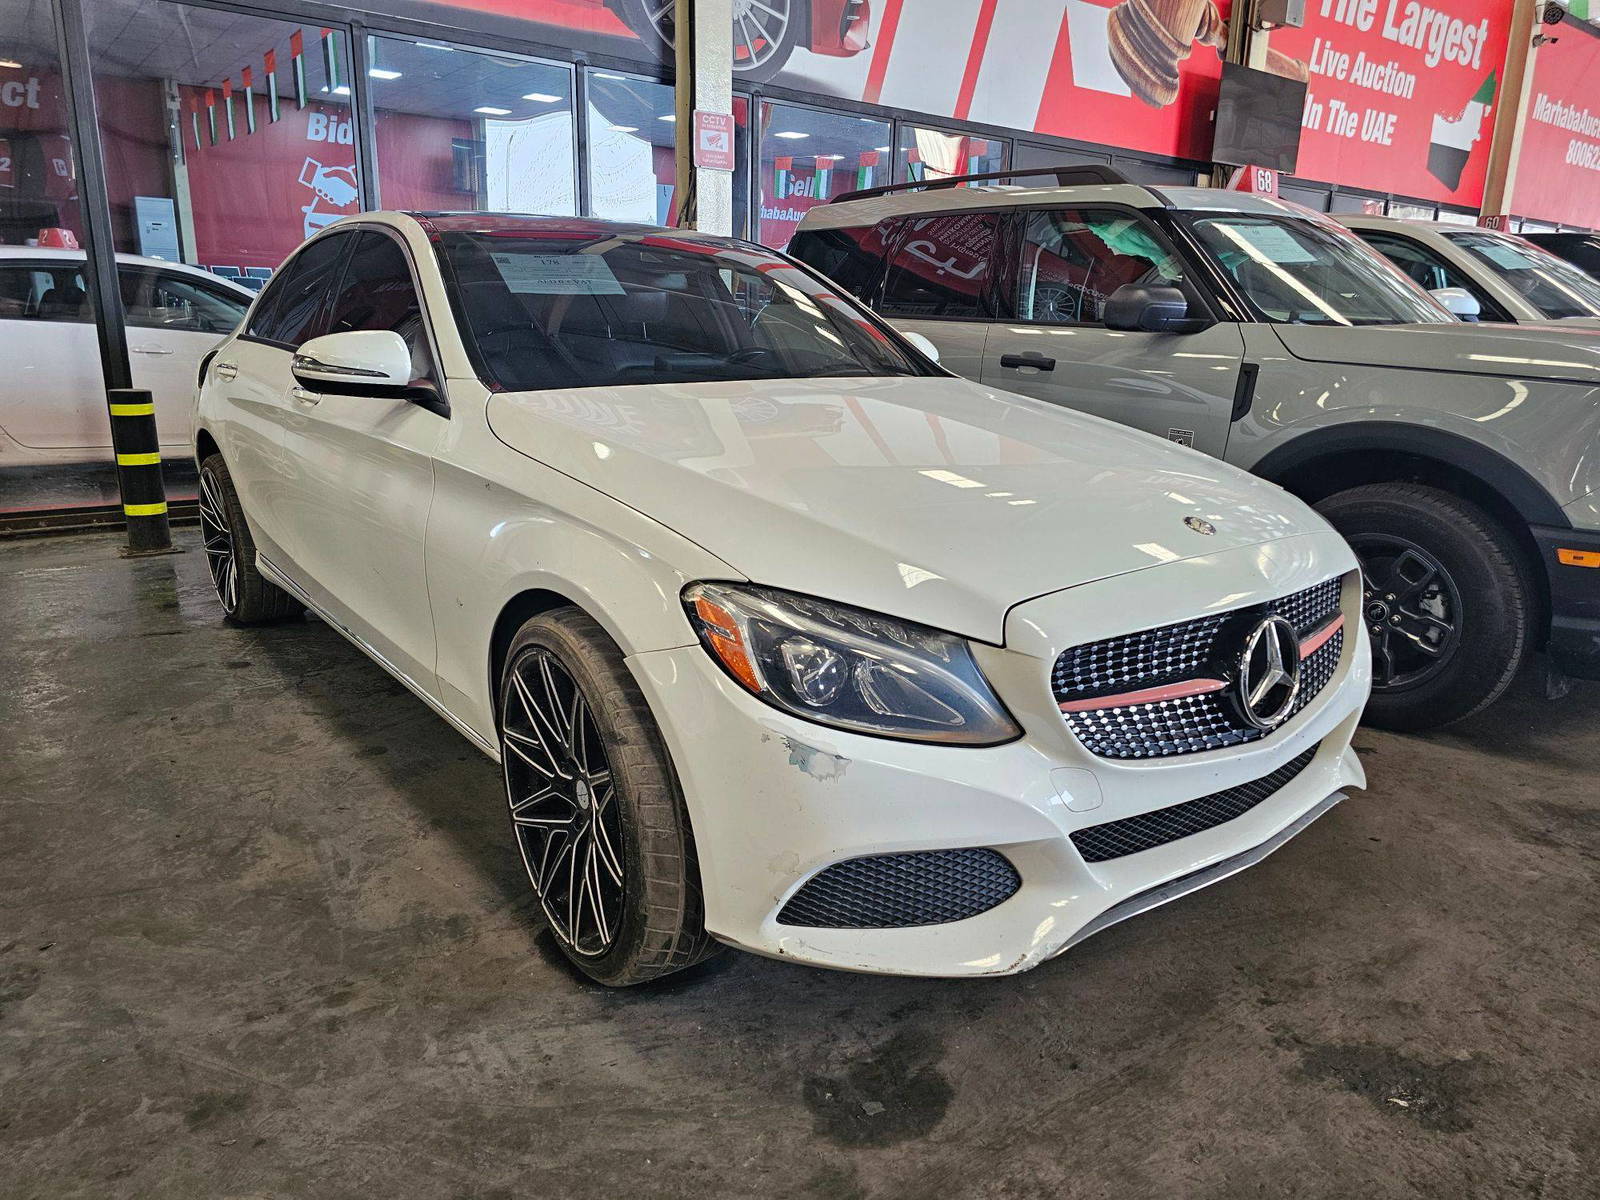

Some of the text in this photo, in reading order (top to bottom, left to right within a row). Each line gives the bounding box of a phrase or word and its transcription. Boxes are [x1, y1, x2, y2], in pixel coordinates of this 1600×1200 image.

[1382, 0, 1488, 71] Largest
[1309, 37, 1416, 100] Live Auction
[307, 112, 354, 145] Bid
[702, 115, 726, 126] CCTV
[1302, 93, 1397, 146] In The UAE
[1257, 169, 1272, 193] 68
[1486, 216, 1500, 229] 60
